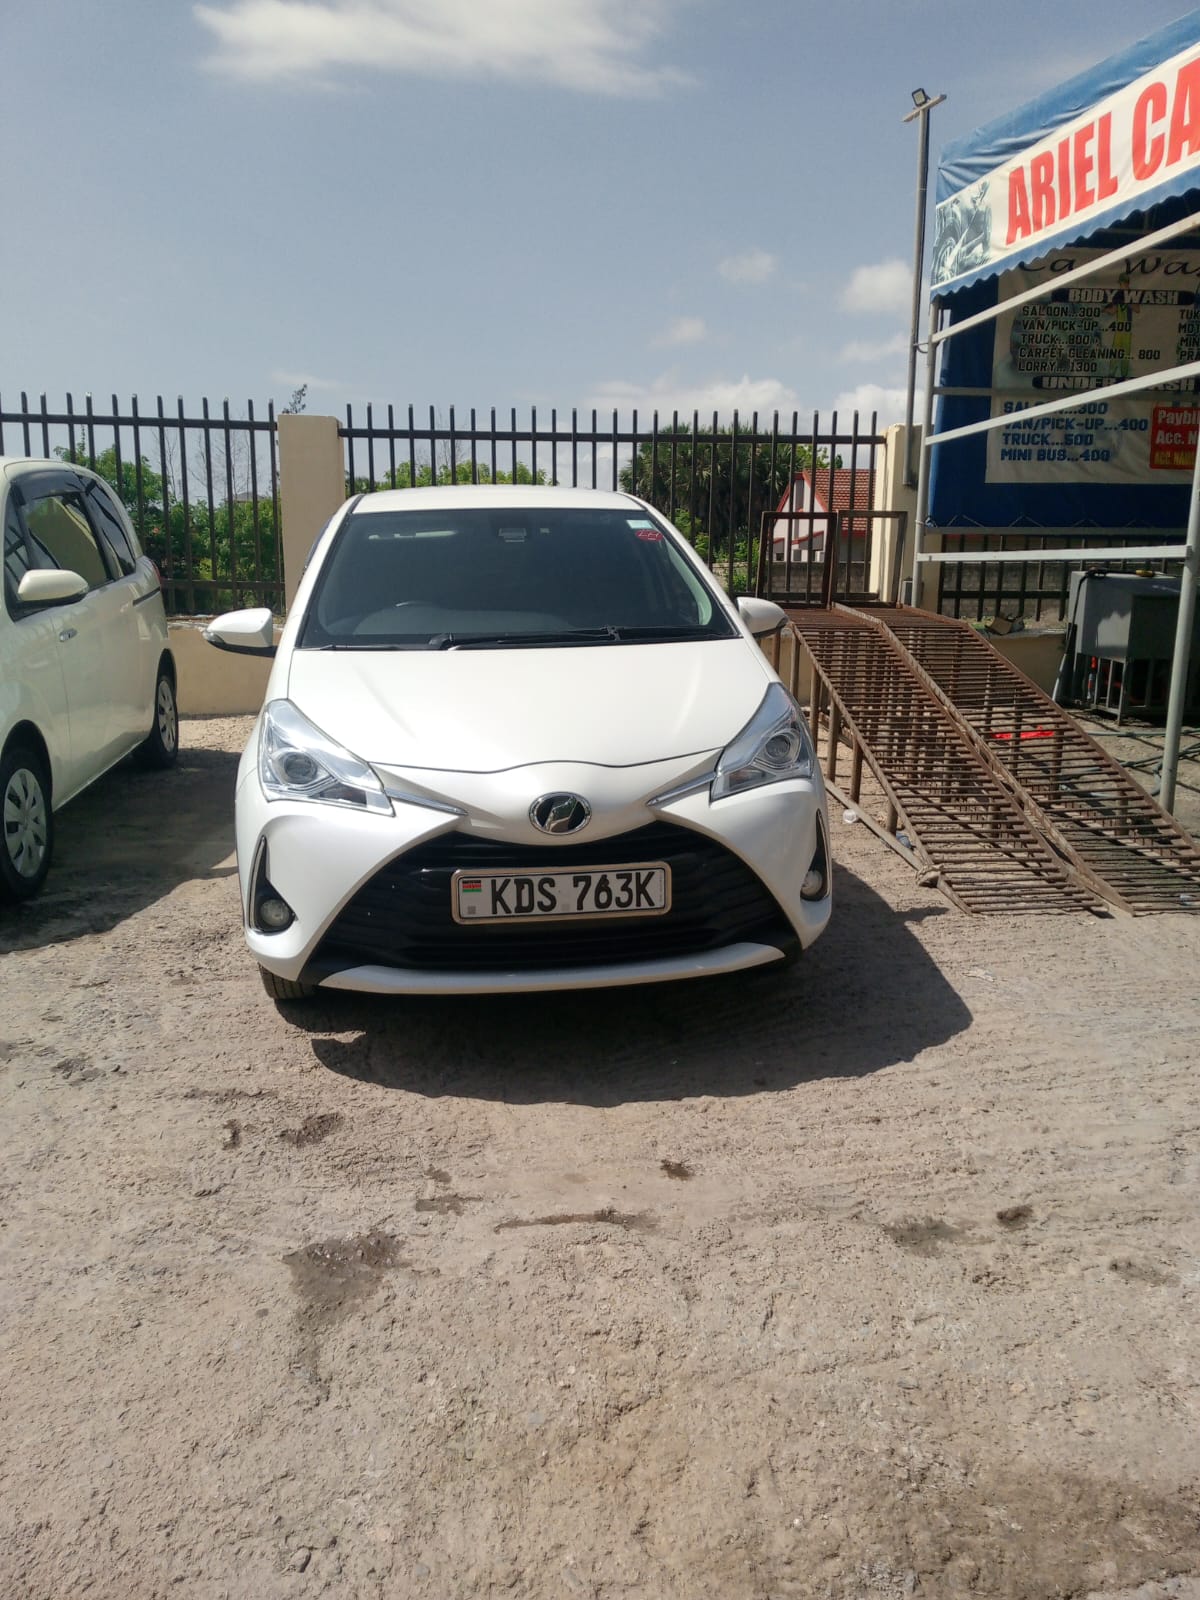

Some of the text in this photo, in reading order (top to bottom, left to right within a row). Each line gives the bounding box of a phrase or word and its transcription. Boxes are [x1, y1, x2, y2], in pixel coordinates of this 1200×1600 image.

[1005, 111, 1118, 246] ARIEL
[1068, 289, 1178, 305] BODY WASH
[1019, 348, 1064, 359] CARPET
[1138, 350, 1160, 360] 800
[1070, 362, 1097, 372] 1300
[1000, 449, 1032, 461] MINI
[491, 877, 557, 915] KDS
[573, 871, 655, 910] 763K
